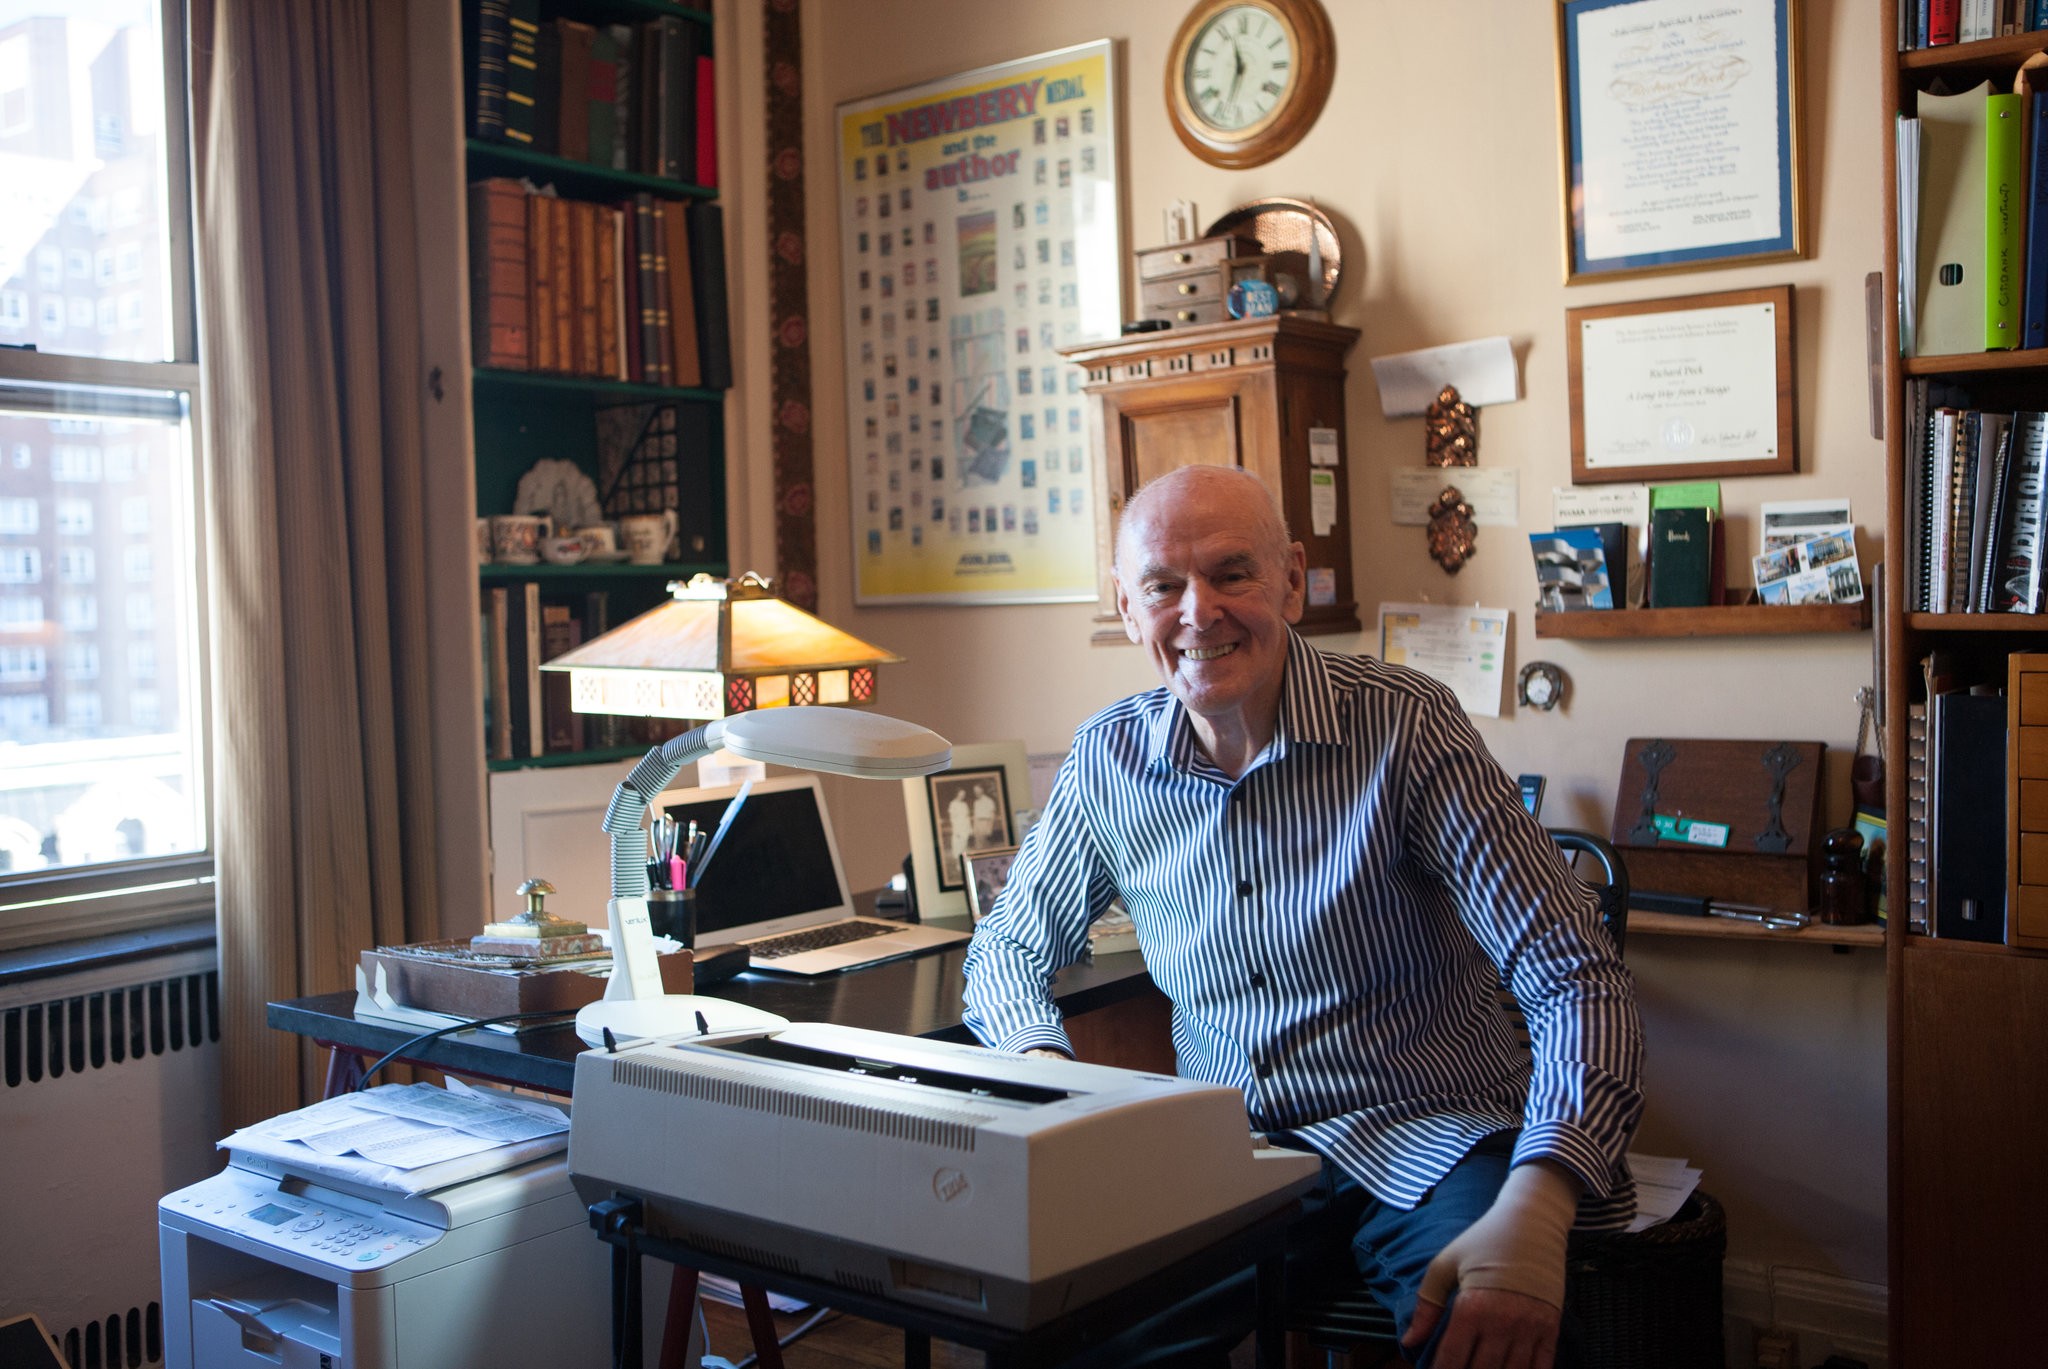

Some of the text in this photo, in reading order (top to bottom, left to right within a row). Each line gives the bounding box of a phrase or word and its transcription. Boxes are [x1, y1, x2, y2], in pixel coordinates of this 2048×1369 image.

[885, 79, 1045, 147] NEWBERY
[943, 133, 996, 157] and the
[924, 150, 1021, 190] author
[1245, 290, 1271, 303] BEST
[2021, 420, 2045, 468] FADE
[2018, 471, 2042, 496] TO
[2009, 498, 2039, 560] BLACK
